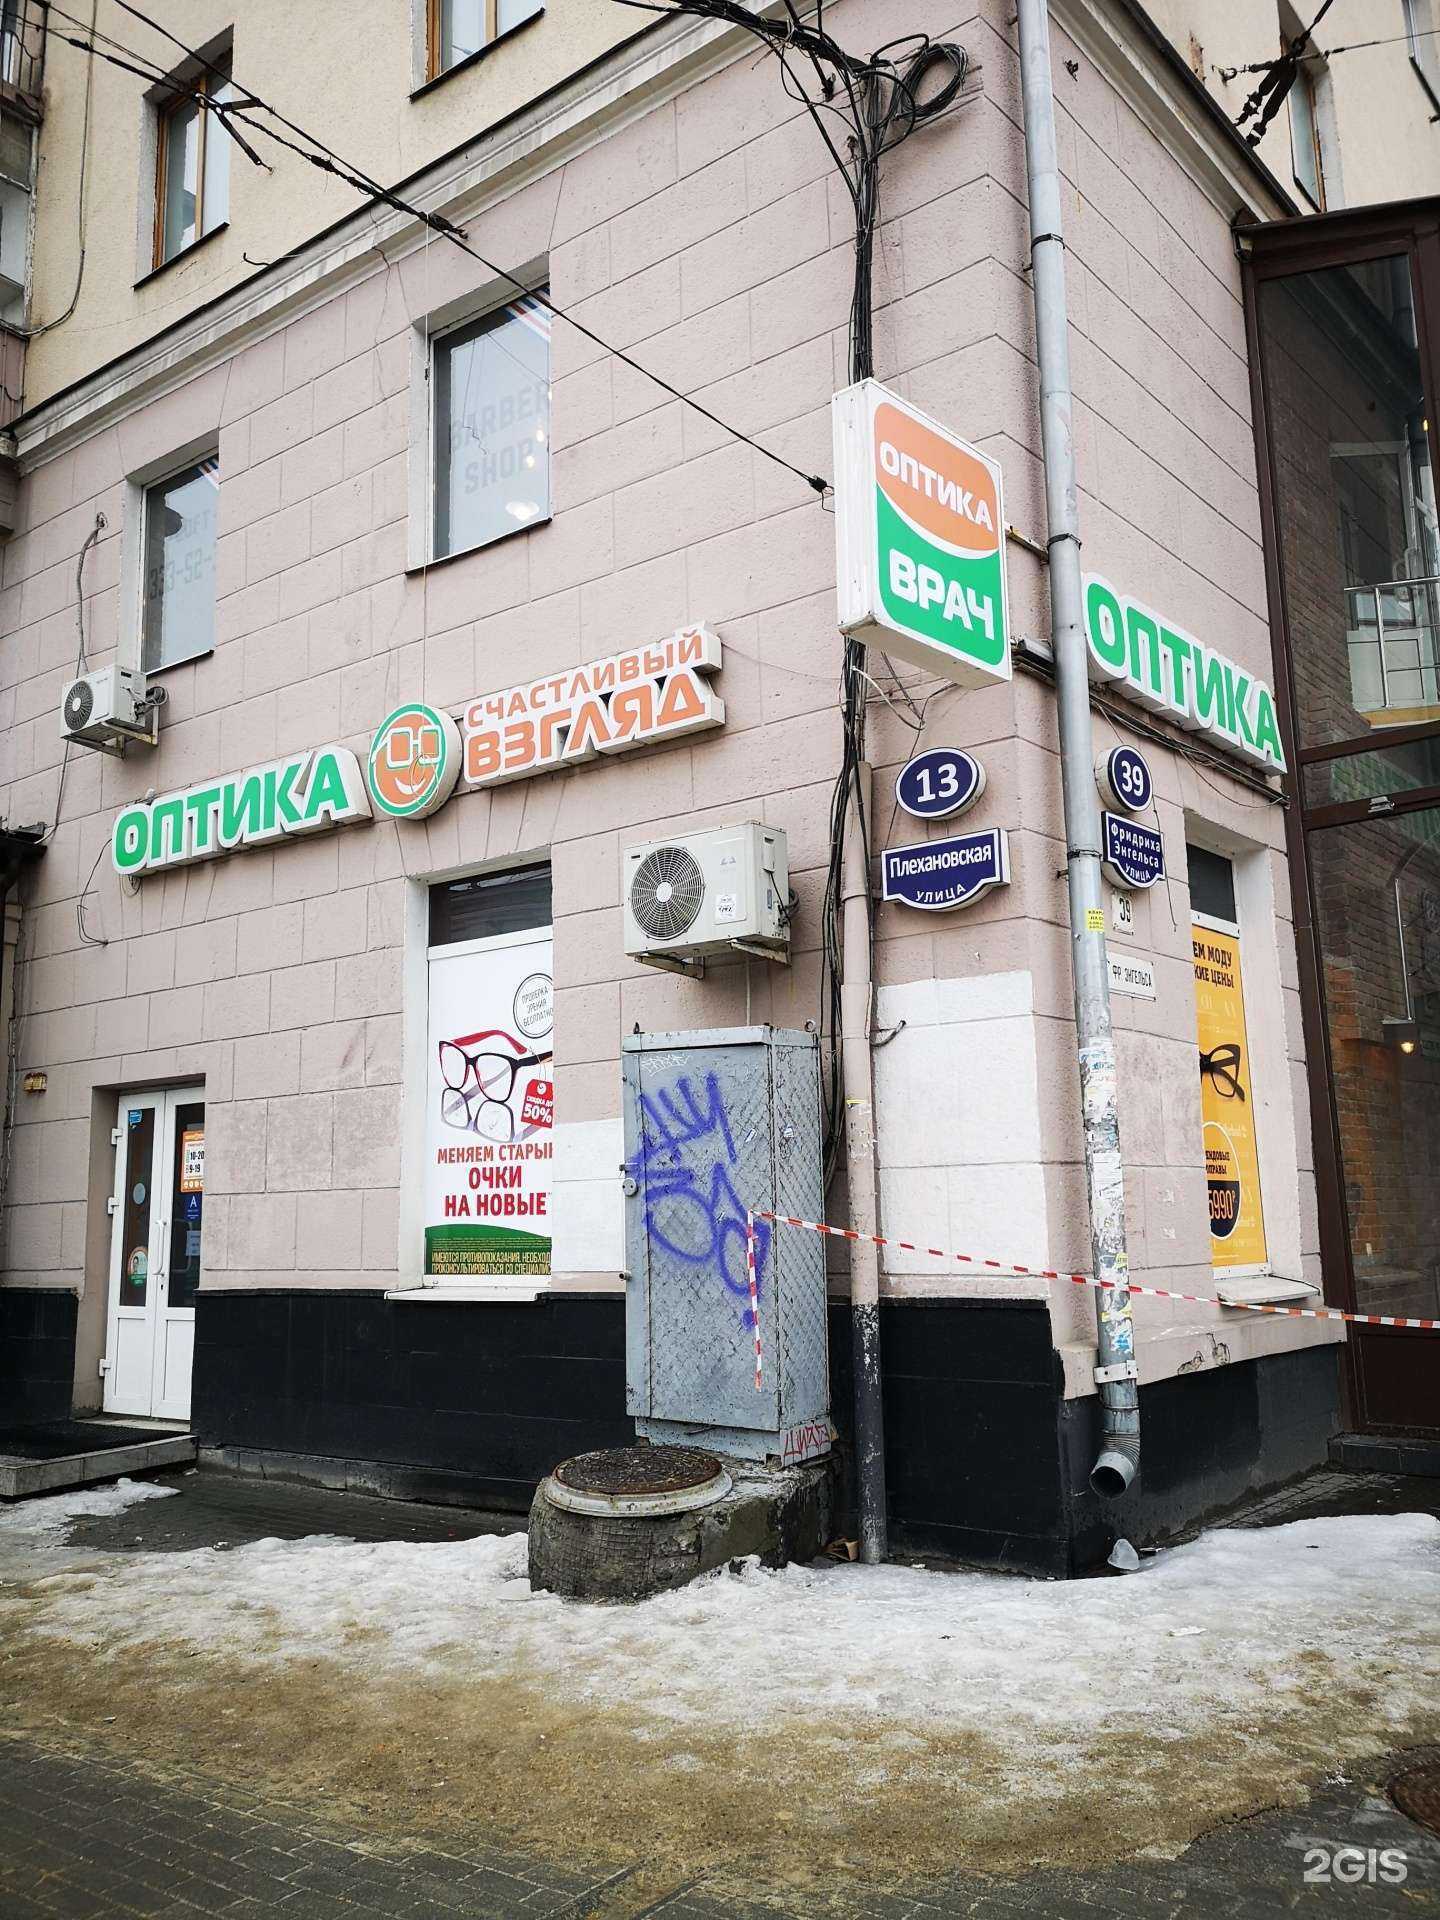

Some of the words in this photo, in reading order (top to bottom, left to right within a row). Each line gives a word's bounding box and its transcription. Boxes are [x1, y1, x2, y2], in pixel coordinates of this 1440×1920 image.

[464, 437, 531, 495] SHOP
[880, 441, 993, 532] ОПТИКА
[889, 548, 995, 641] ВРАЧ
[468, 629, 704, 729] СЧАСТЛИВЫЙ
[1087, 582, 1283, 762] ОПТИКА
[467, 679, 706, 779] ВЗГЛЯД
[916, 763, 959, 802] 13
[1121, 760, 1143, 796] 39
[114, 753, 349, 867] ОПТИКА
[1111, 822, 1161, 853] Фридриха
[890, 844, 992, 878] Плехановская
[1114, 840, 1159, 868] Энгельса
[916, 883, 967, 903] УЛИЦА
[1119, 897, 1131, 923] 39
[1207, 945, 1232, 969] МОДУ
[1210, 967, 1234, 988] ЦЕНЫ
[523, 1103, 552, 1123] 50%
[437, 1145, 494, 1164] МЕНЯЕМ
[468, 1165, 522, 1190] ОЧКИ
[445, 1194, 470, 1217] НА
[476, 1192, 547, 1217] НОВЫЕ
[432, 1252, 459, 1263] ИМЕЮТСЯ
[432, 1263, 504, 1274] ПРОКОНСУЛЬТИРОВАТЬСЯ
[505, 1263, 513, 1274] СО
